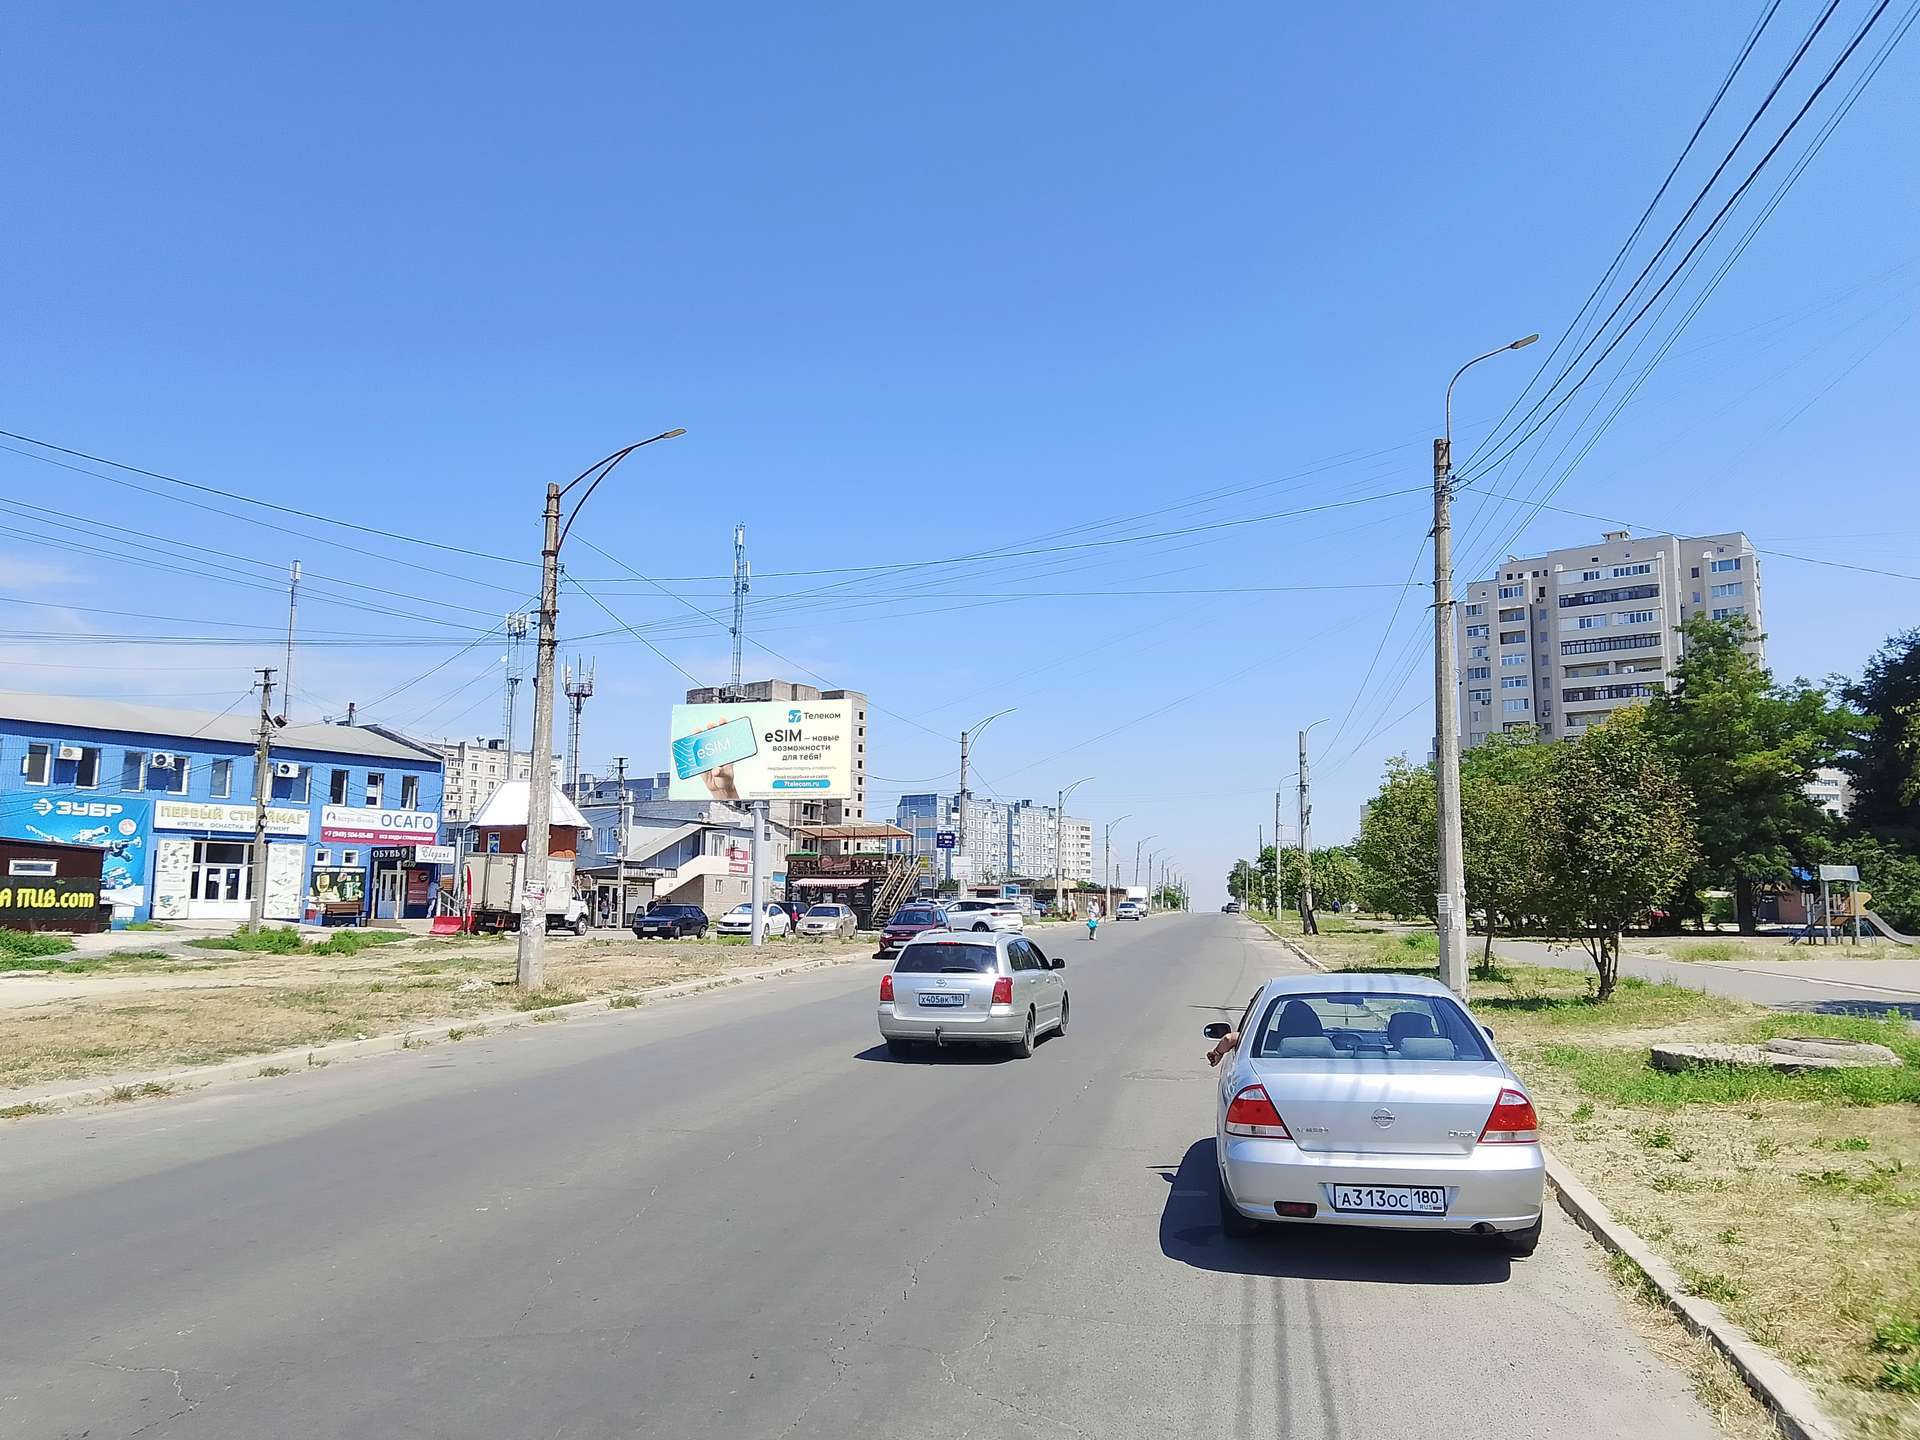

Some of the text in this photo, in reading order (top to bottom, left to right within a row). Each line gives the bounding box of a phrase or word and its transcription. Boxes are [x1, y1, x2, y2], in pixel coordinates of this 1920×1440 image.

[803, 712, 841, 720] Телеком
[764, 729, 802, 742] eSIM
[697, 737, 730, 759] eSIM
[799, 753, 822, 761] тебя!
[56, 801, 124, 818] ЗУБР
[160, 806, 305, 825] ПЕРВЫЙ СТРЙМАГ
[250, 824, 289, 832] ИРУМЕНТ
[381, 814, 433, 830] ОСАГО
[373, 849, 400, 858] ОБУВЬ
[1341, 1189, 1439, 1208] А313ОС 180
